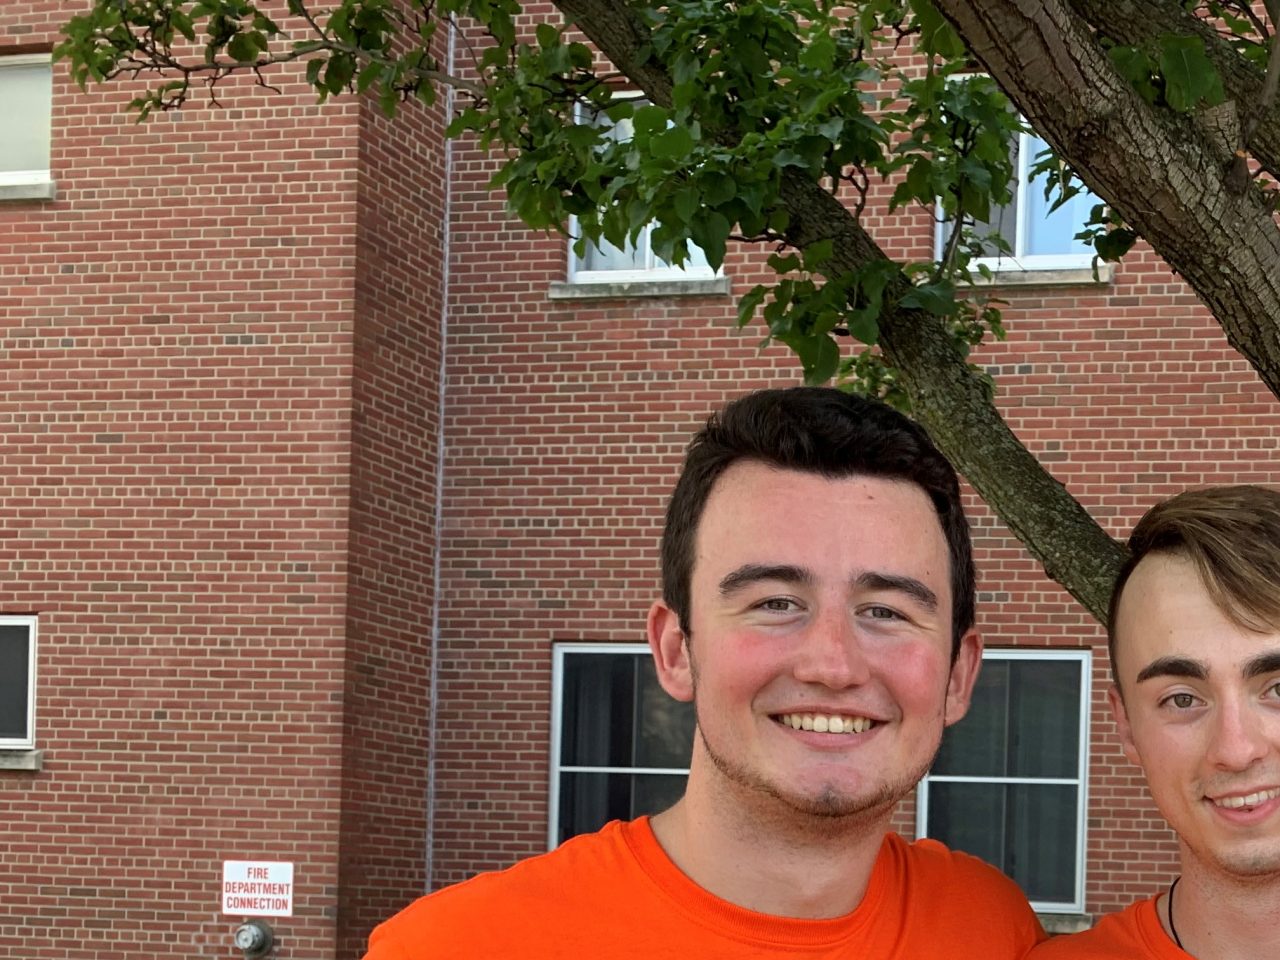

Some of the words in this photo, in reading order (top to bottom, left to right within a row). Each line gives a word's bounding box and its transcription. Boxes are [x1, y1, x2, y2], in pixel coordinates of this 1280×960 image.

[247, 867, 269, 879] FIRE
[225, 882, 291, 895] DEPARTMENT
[226, 896, 288, 910] CONNECTION
